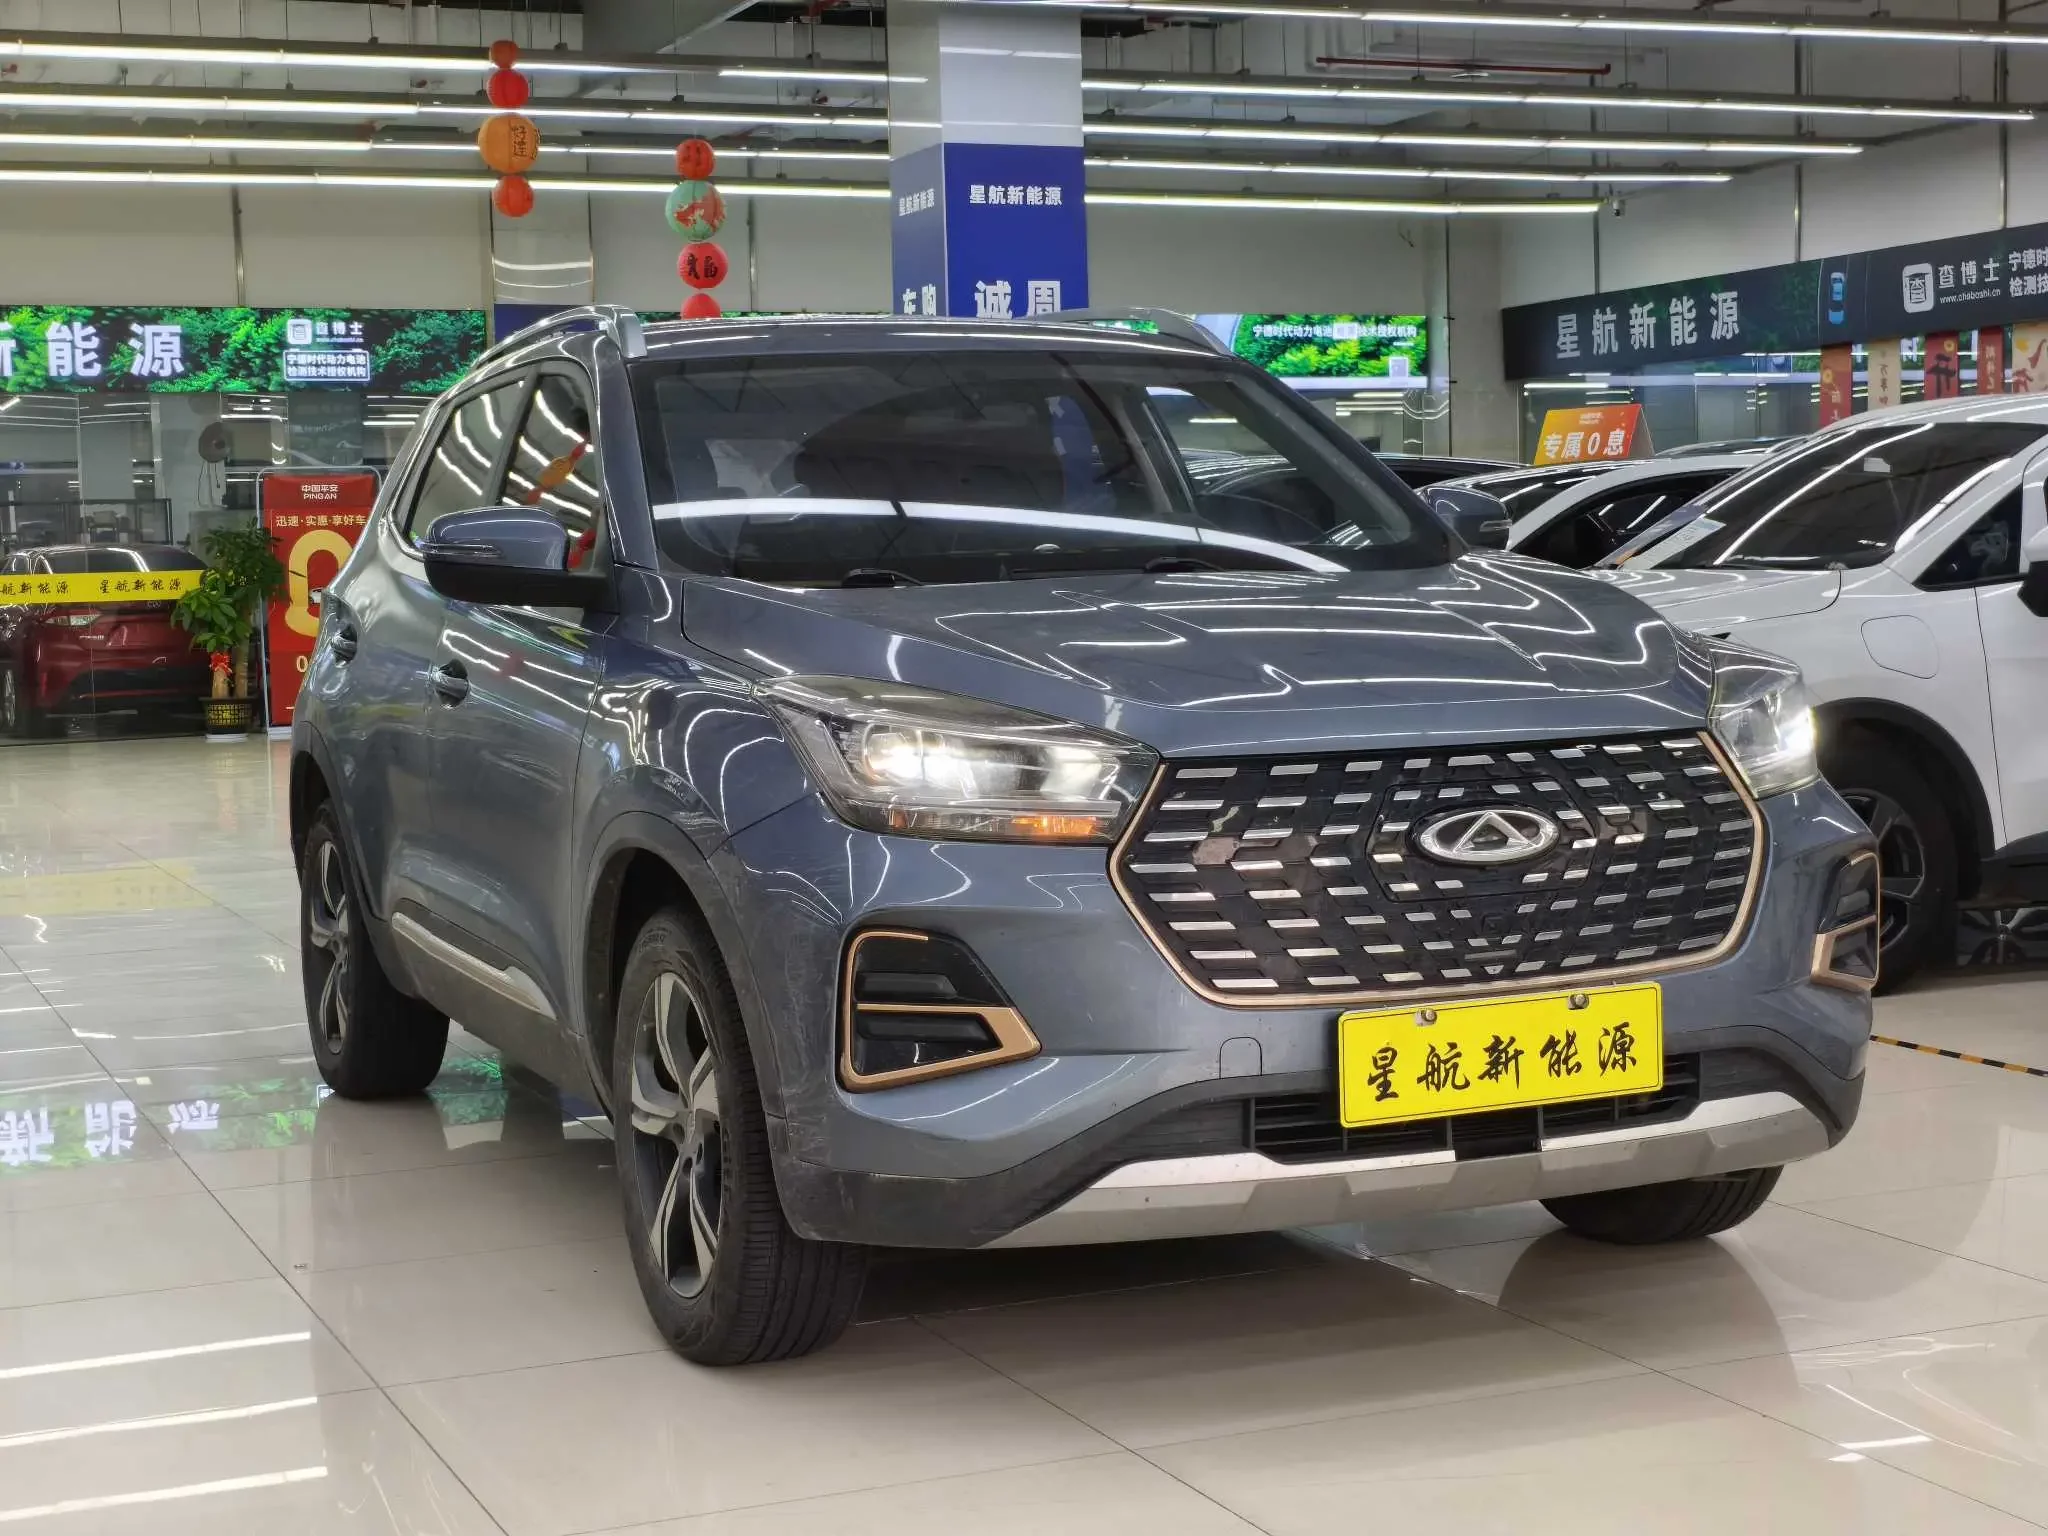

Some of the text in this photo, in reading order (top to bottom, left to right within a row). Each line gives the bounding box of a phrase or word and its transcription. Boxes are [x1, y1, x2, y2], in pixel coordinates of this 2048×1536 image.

[969, 184, 1063, 206] 星航新能源
[1938, 257, 2000, 289] 查博士
[1556, 291, 1740, 359] 星航新能源
[301, 484, 339, 493] 中国平安
[99, 579, 182, 594] 星航新能源
[1367, 1021, 1637, 1102] 星航新能源
